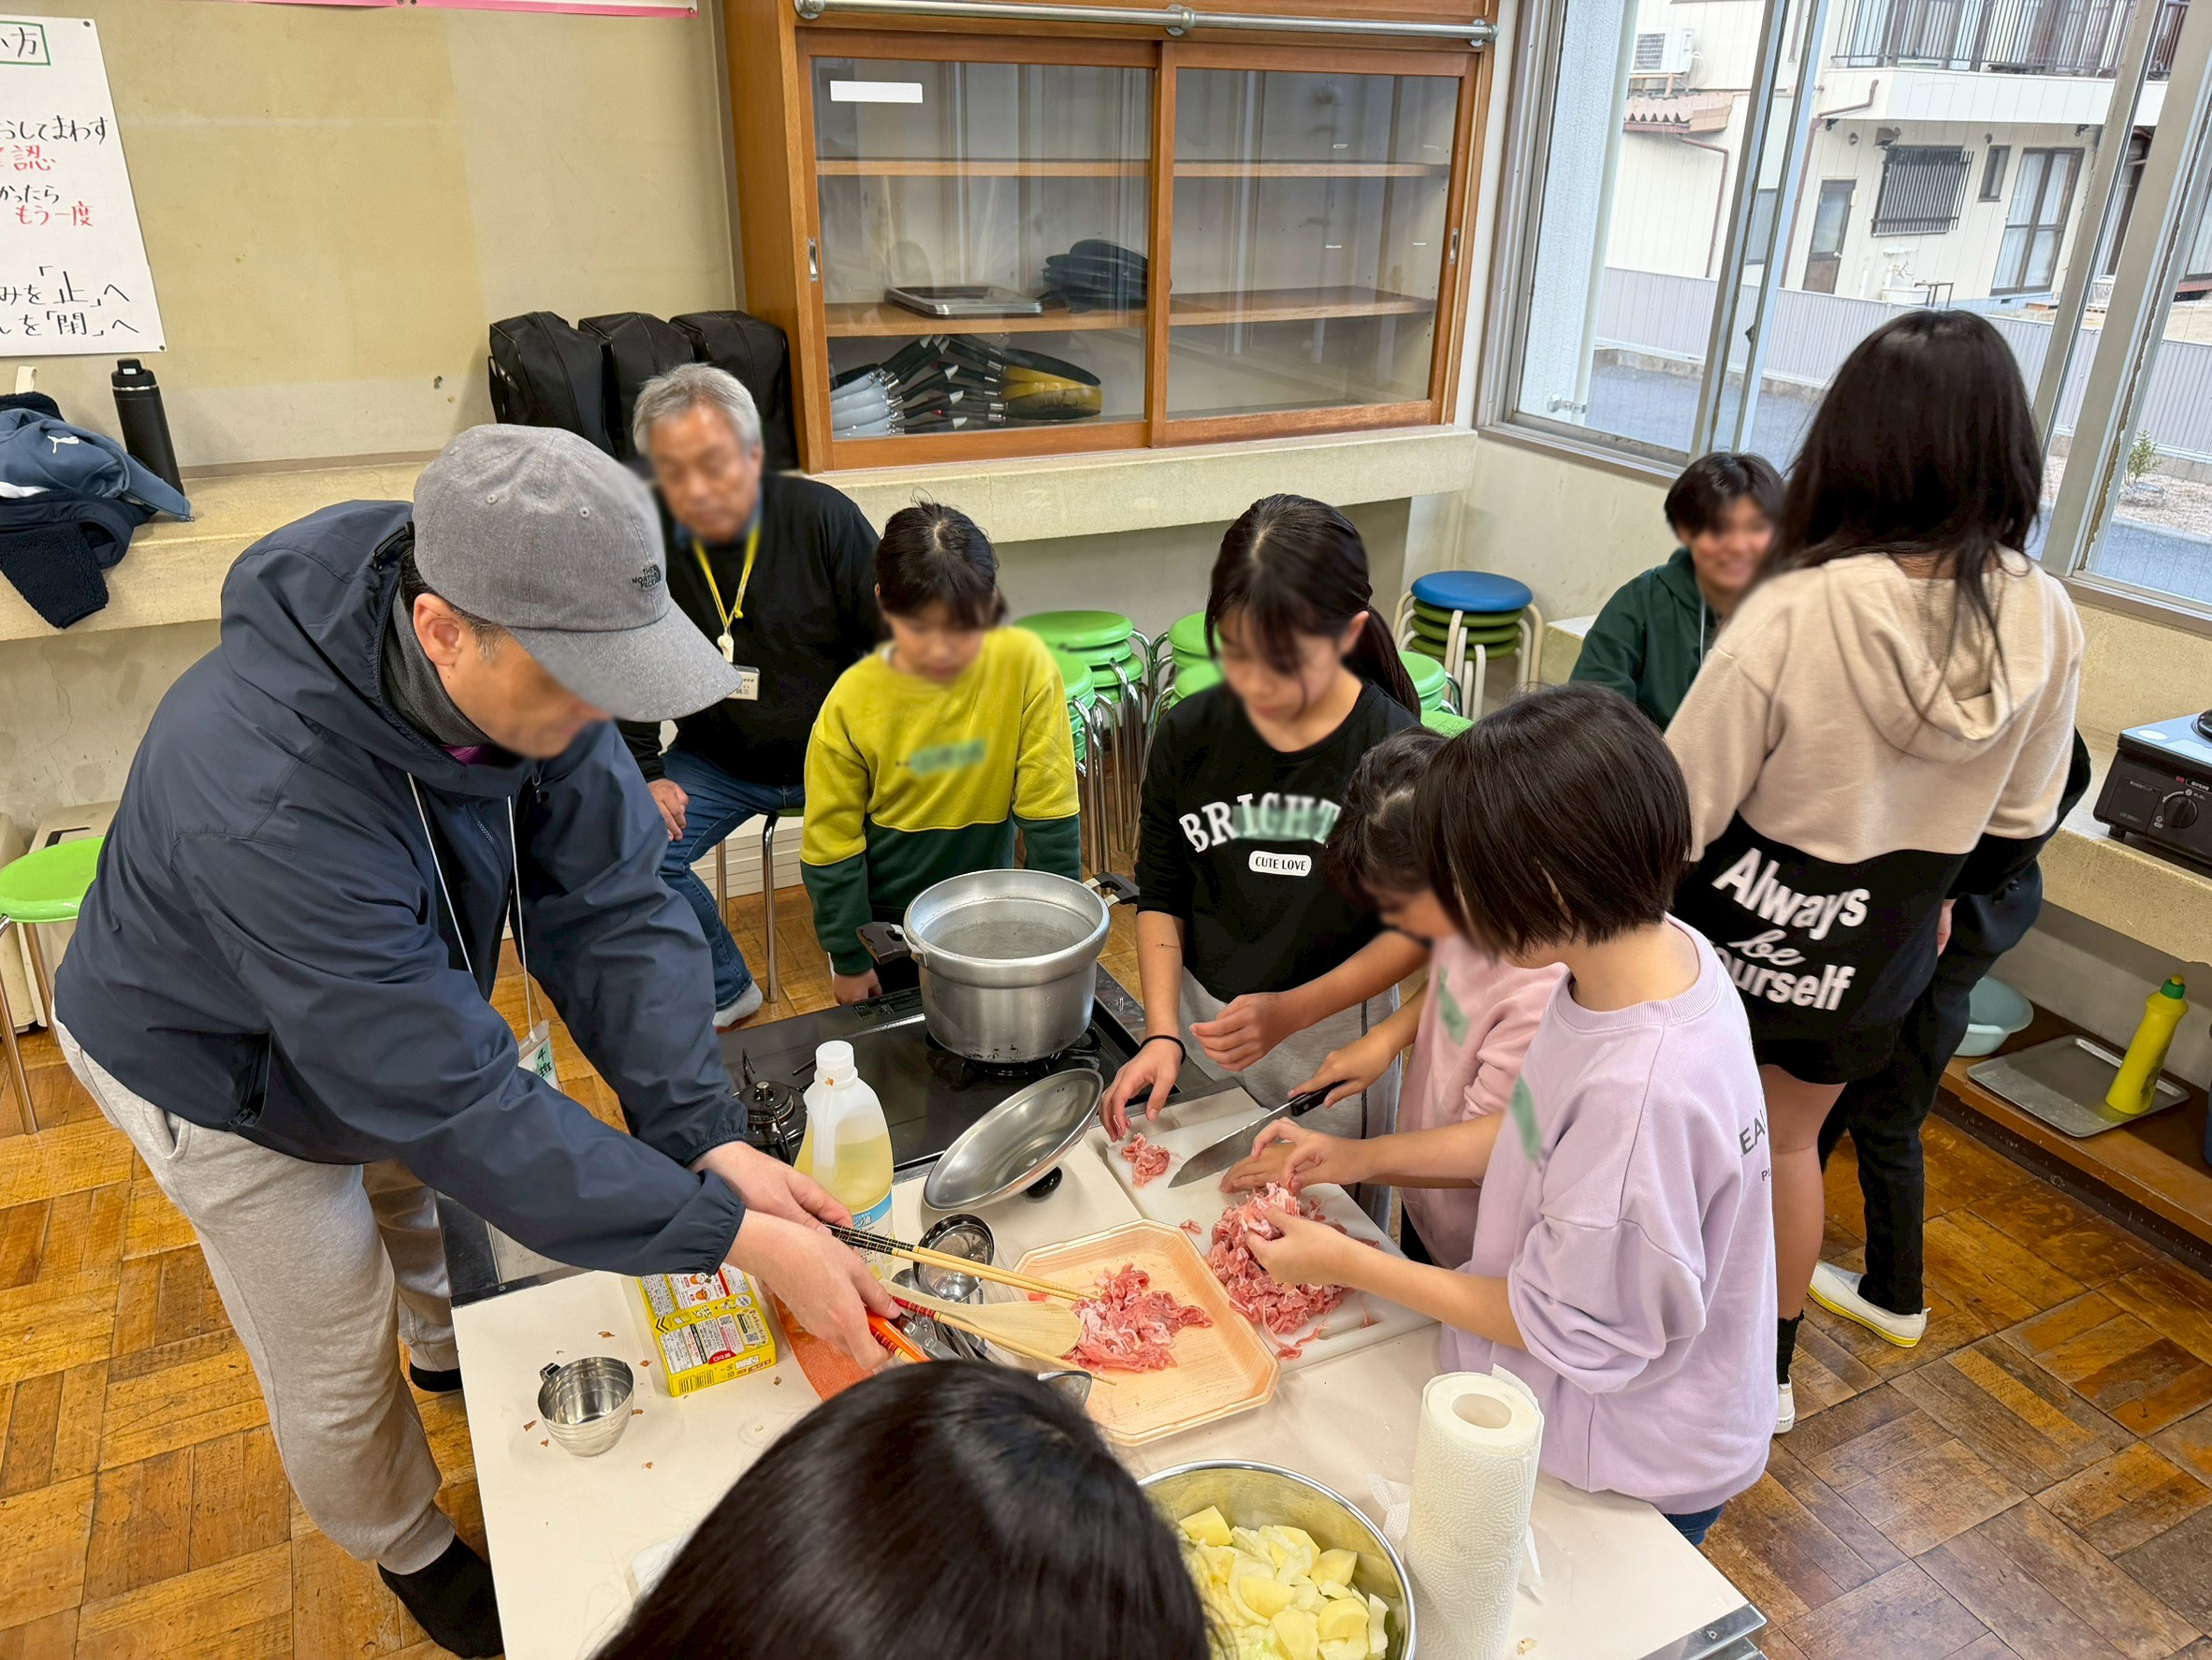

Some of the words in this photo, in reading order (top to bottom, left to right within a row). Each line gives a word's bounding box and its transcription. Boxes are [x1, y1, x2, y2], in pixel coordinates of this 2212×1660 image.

[0, 145, 56, 171] 認
[15, 200, 94, 227] もう一度
[1255, 855, 1279, 869] CUTE
[1281, 859, 1306, 871] LOVE
[1711, 847, 1871, 940] Always
[1727, 928, 1807, 967] be
[1712, 942, 1856, 1012] ourself
